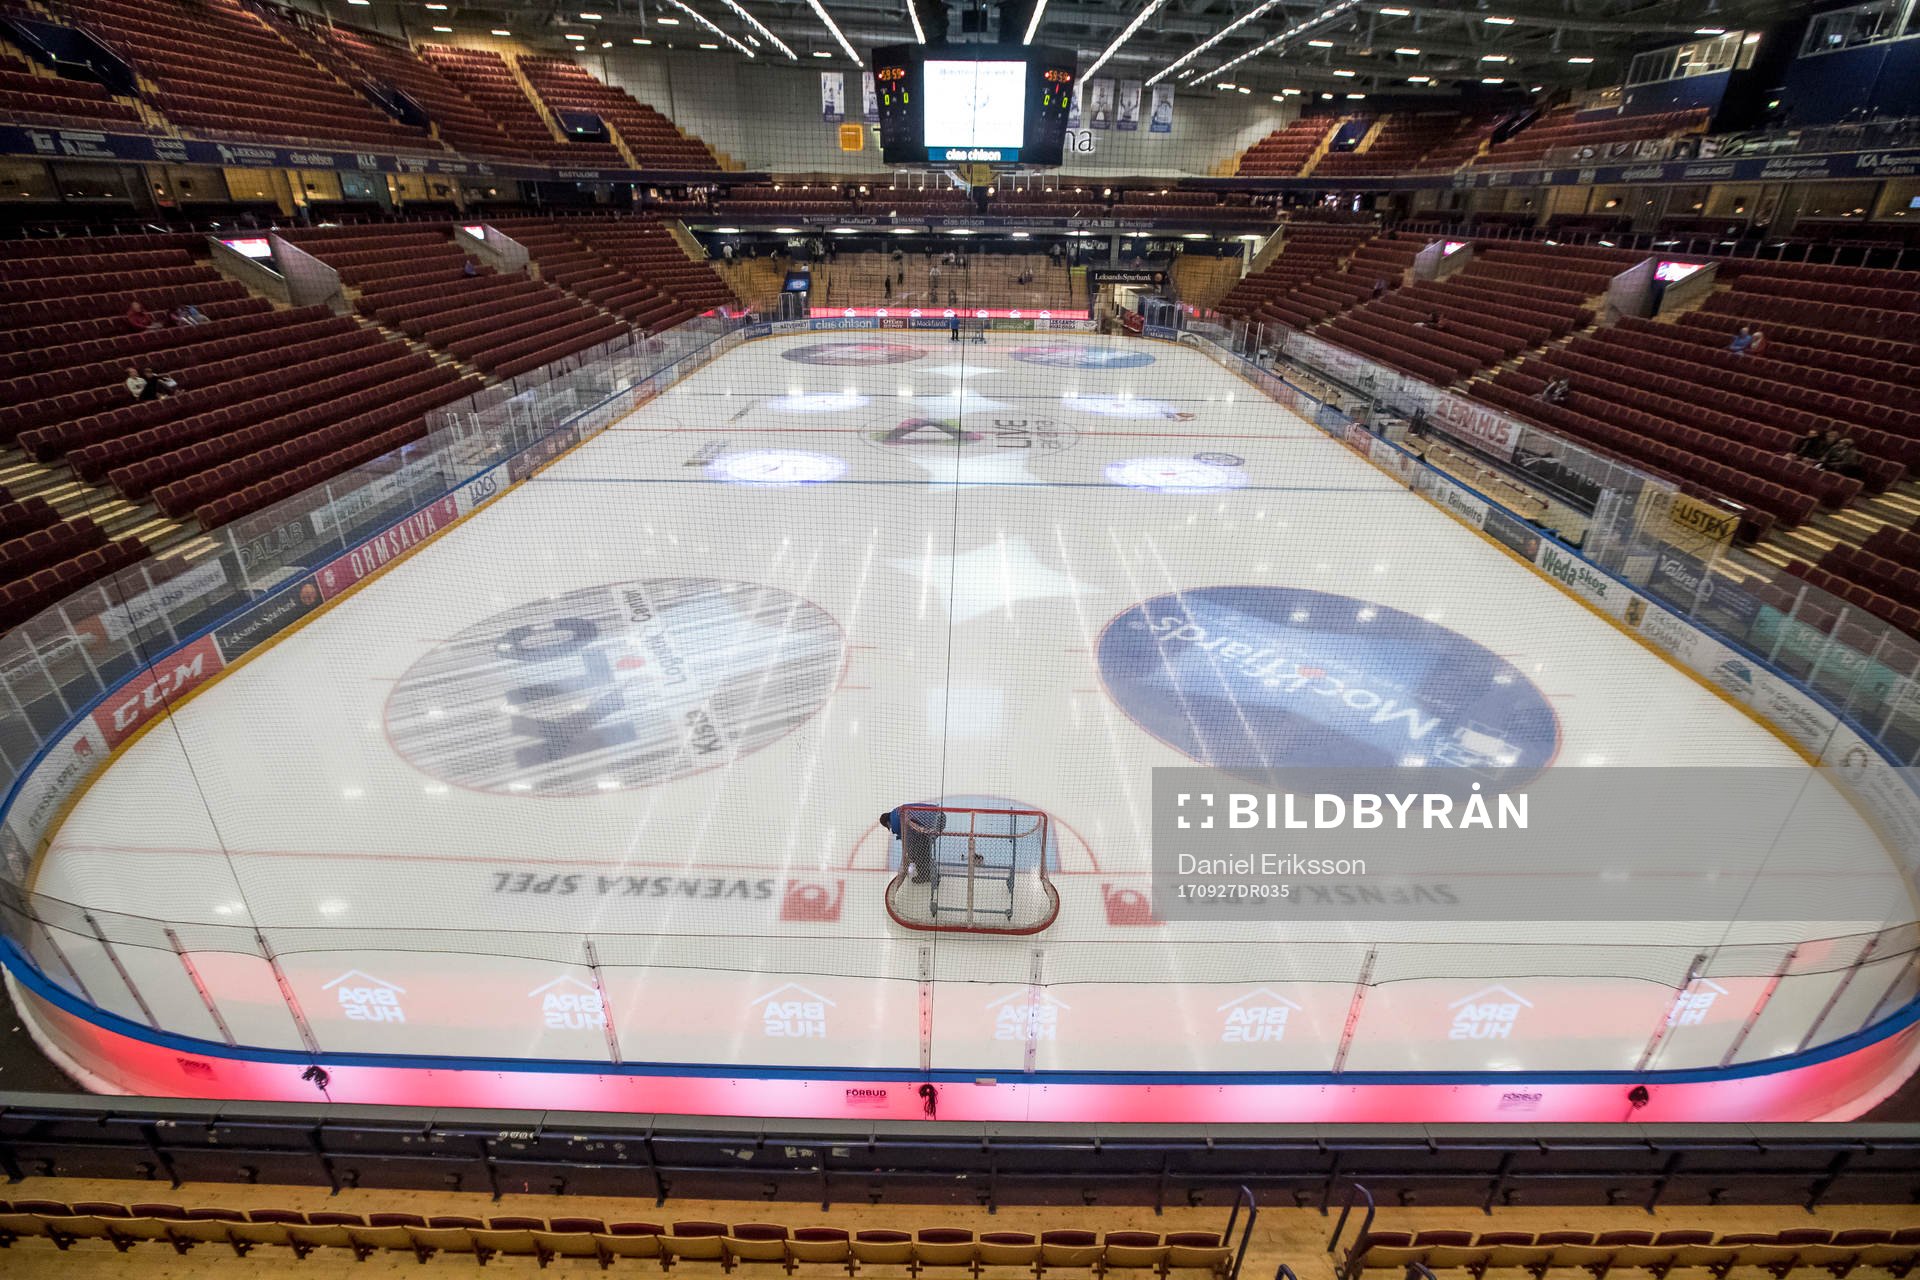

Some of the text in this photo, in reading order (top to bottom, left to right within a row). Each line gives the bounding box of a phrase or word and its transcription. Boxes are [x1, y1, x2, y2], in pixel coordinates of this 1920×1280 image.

[1855, 153, 1878, 168] ICA
[816, 321, 838, 329] clas
[839, 318, 871, 329] ohlson
[351, 509, 436, 578] ORMSALVA
[1541, 546, 1608, 597] Weda Skog
[112, 651, 204, 732] CCM
[493, 872, 775, 899] SVENSKA SPEL
[846, 1088, 887, 1097] FÖRBUD
